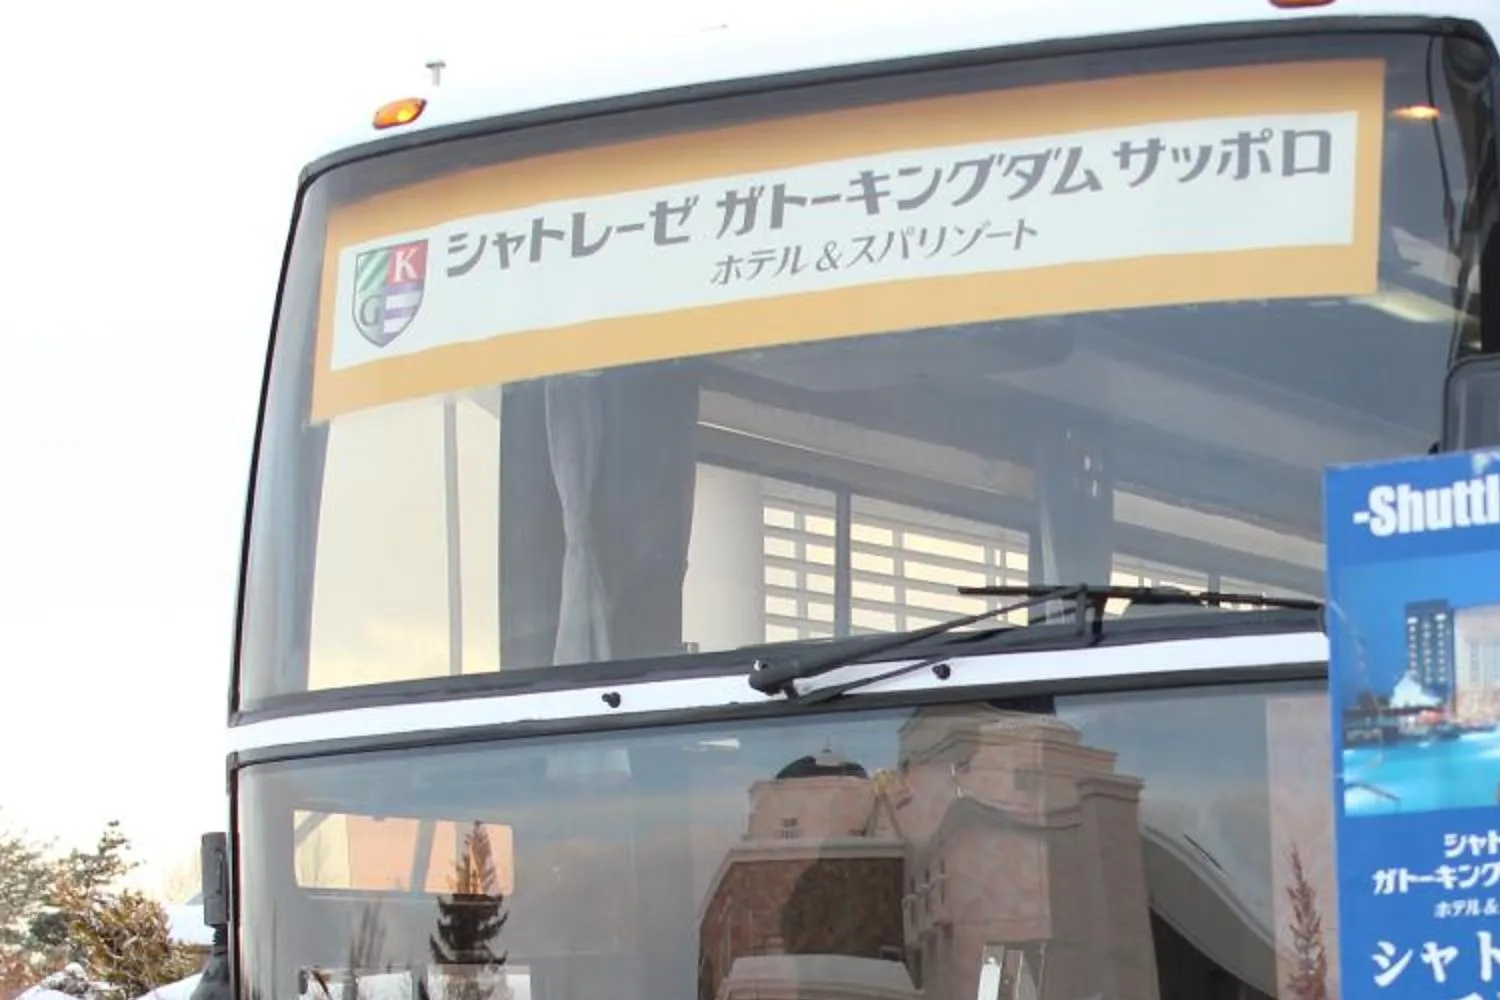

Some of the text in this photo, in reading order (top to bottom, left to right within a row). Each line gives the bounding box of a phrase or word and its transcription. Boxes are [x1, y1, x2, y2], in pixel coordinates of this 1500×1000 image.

[447, 127, 1333, 277] シャトレーゼ ガトーキングダム サッポロ
